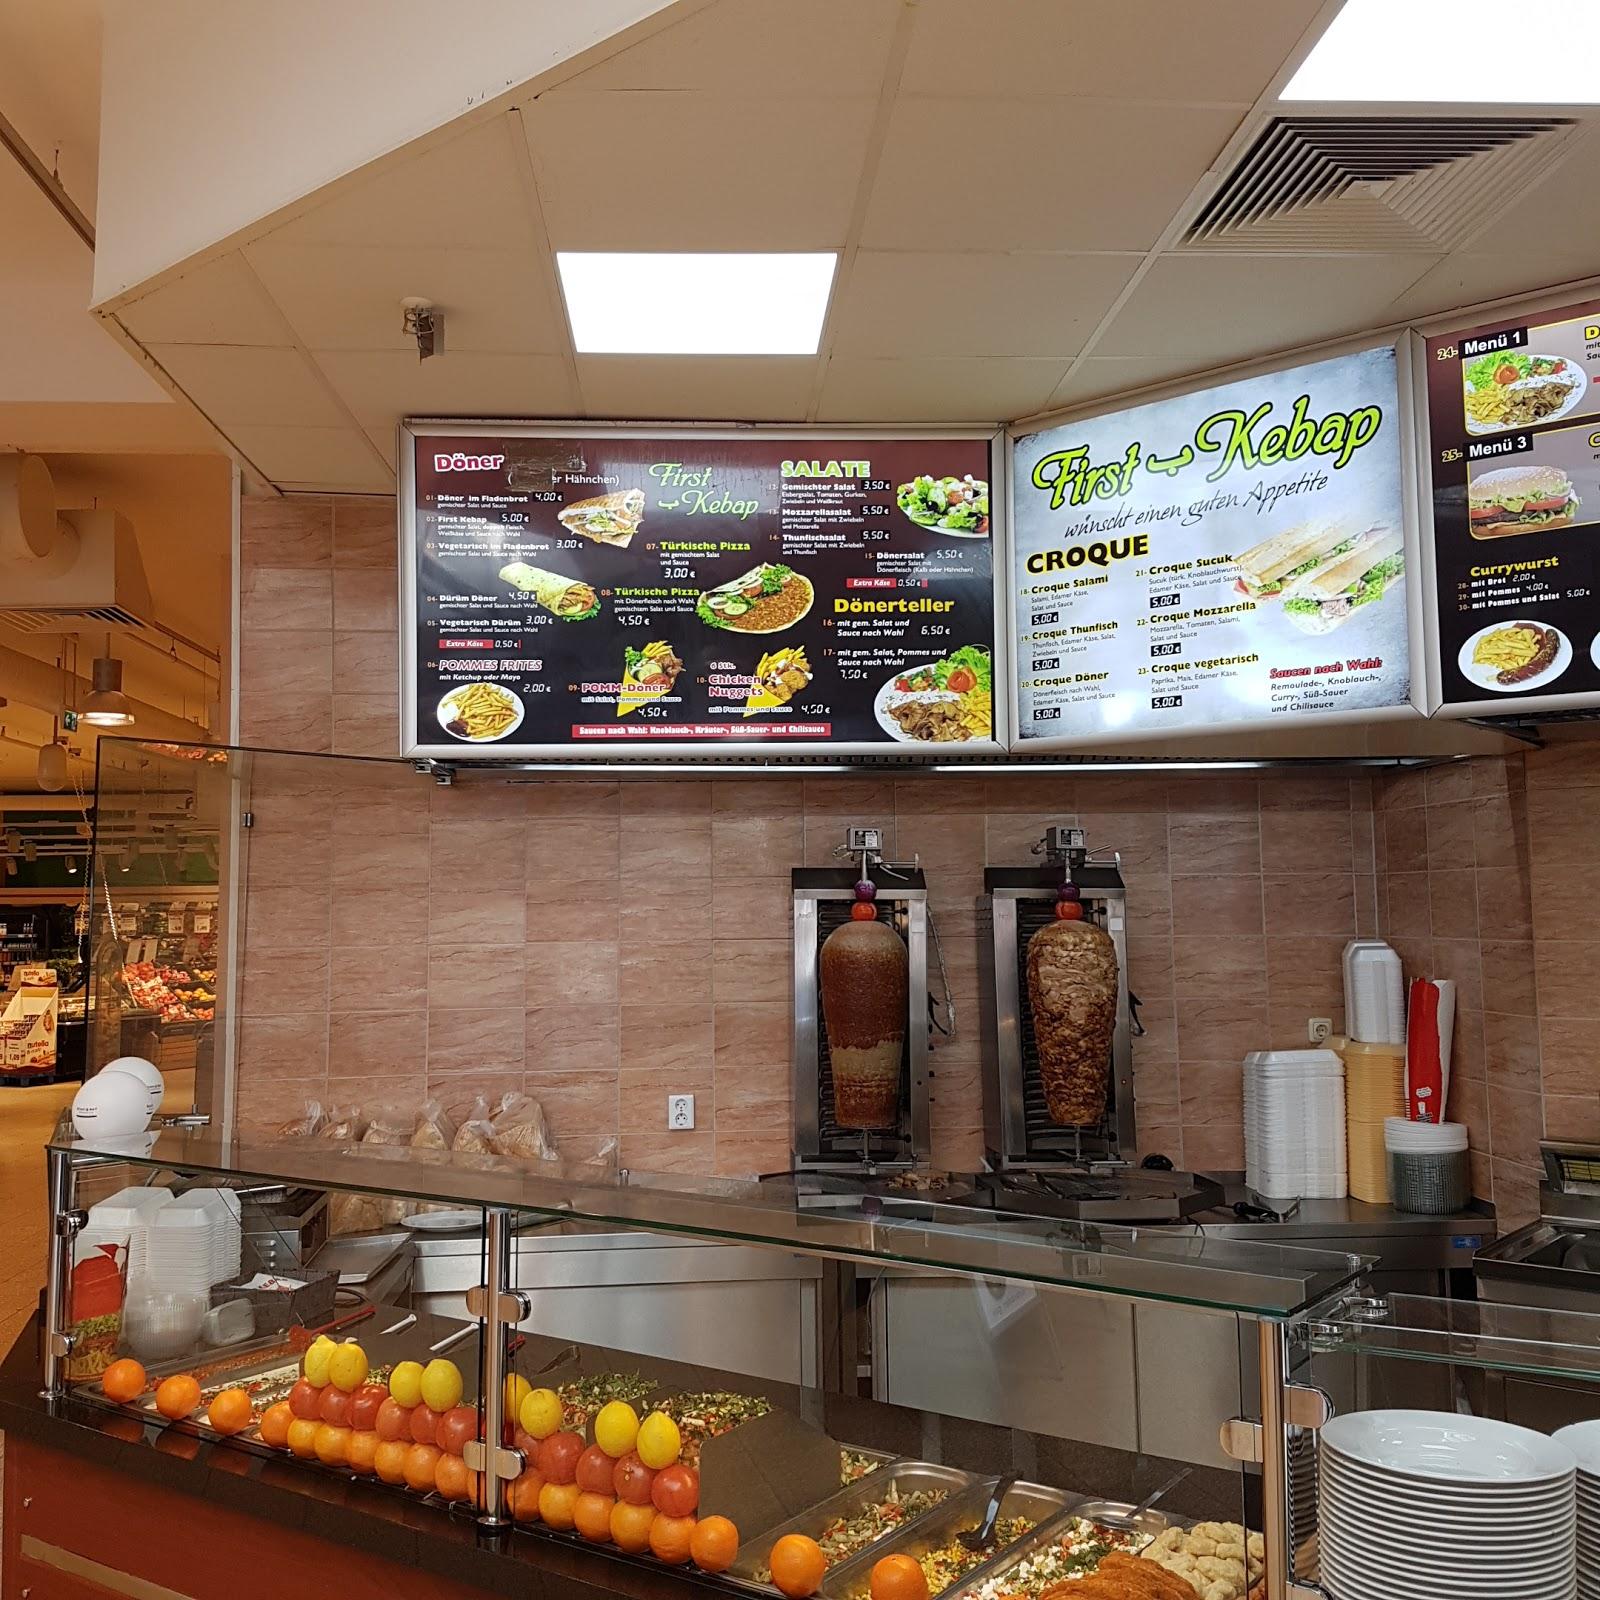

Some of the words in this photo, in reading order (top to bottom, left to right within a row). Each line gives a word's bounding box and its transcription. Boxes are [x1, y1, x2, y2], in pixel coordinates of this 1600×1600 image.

[1465, 335, 1507, 354] Menü
[1512, 332, 1520, 344] 1
[1031, 442, 1140, 510] First
[1194, 395, 1382, 483] Kebap
[1469, 438, 1512, 457] Menü
[1517, 437, 1526, 448] 3
[434, 453, 504, 472] Döner
[781, 461, 870, 477] SALATE
[566, 475, 619, 484] Hähnchen)
[649, 463, 712, 486] First
[682, 490, 759, 520] Kebap
[1065, 502, 1134, 538] wünscht
[1137, 505, 1182, 523] einen
[1181, 492, 1241, 527] guten
[1243, 469, 1328, 516] Appetite
[438, 543, 488, 551] Vegetarisch
[660, 542, 716, 550] Türkische
[1027, 534, 1148, 574] CROQUE
[1150, 562, 1192, 575] Croque
[1196, 555, 1232, 567] Sucuk
[1471, 556, 1559, 577] Currywurst
[614, 588, 667, 596] Türkische
[1031, 582, 1070, 594] Croque
[1073, 575, 1108, 587] Salami
[1488, 588, 1520, 596] Pommes
[834, 598, 954, 613] Dönerteller
[1488, 598, 1519, 607] Pommes
[1150, 610, 1190, 624] Croque
[1194, 602, 1256, 617] Mozzarella
[1033, 629, 1067, 640] Croque
[1070, 621, 1118, 634] Thunfisch
[439, 659, 498, 671] POMMES
[500, 660, 542, 670] FRITES
[1152, 662, 1190, 673] Croque
[1194, 654, 1258, 669] vegetarisch
[1270, 668, 1311, 679] Saucen
[1314, 662, 1343, 674] nach
[1346, 657, 1382, 671] Wahl:
[582, 682, 667, 692] POMM-Döner
[709, 675, 762, 684] Chicken
[1033, 676, 1071, 687] Croque
[1076, 671, 1109, 682] Döner
[709, 687, 763, 699] Nuggets
[1304, 689, 1348, 698] Süß-Sauer
[1290, 702, 1333, 710] Chilisauce
[28, 1040, 48, 1048] nutella
